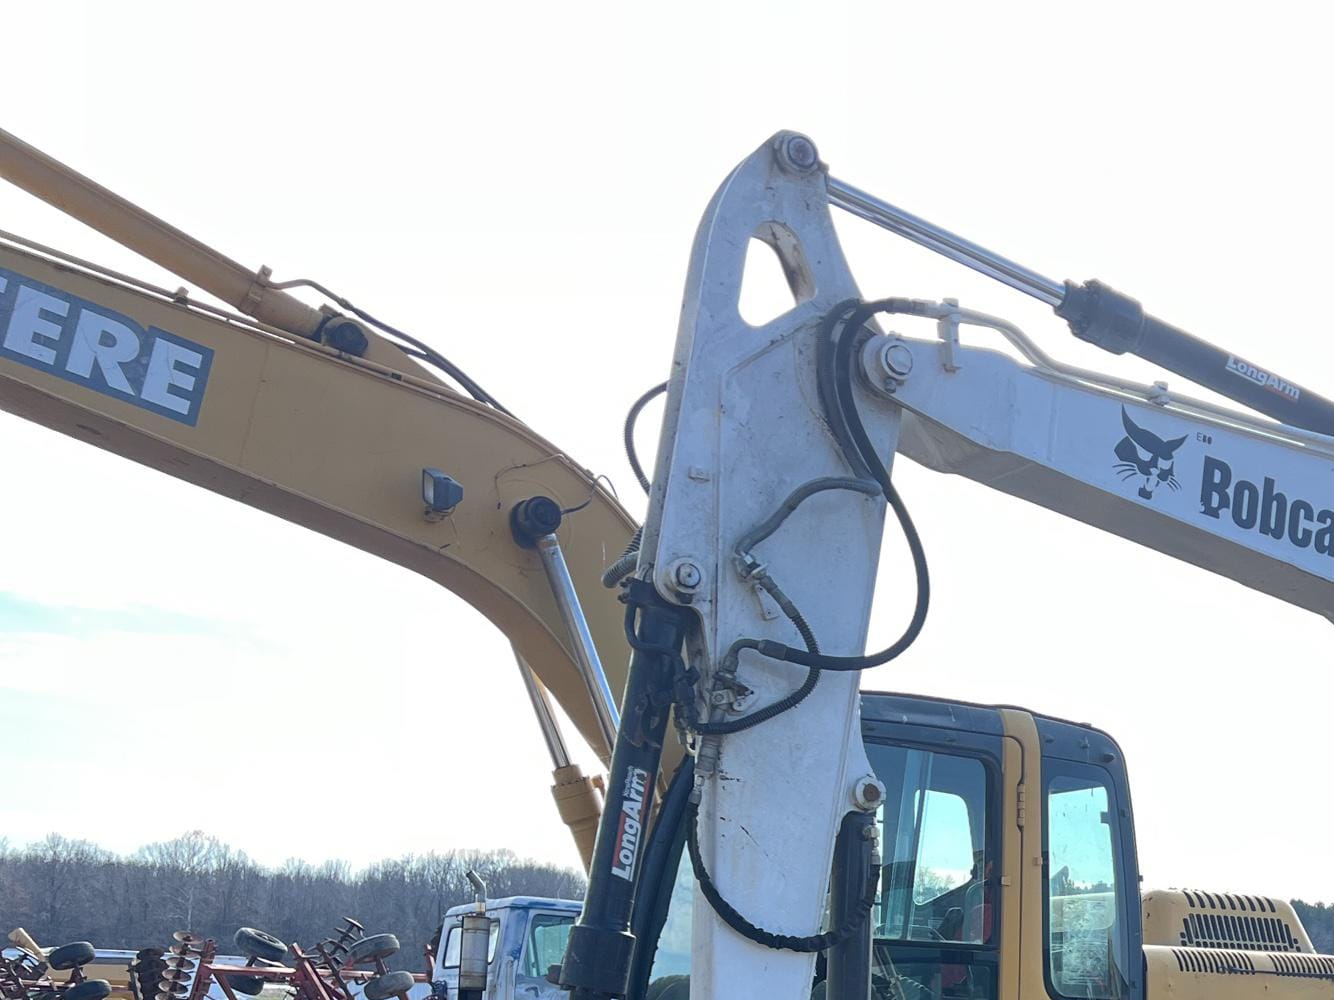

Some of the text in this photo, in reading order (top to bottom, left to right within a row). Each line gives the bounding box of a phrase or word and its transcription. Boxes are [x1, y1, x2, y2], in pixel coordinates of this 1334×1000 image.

[0, 276, 203, 415] ERE
[1226, 355, 1300, 399] LongArm
[611, 768, 648, 882] LongArm
